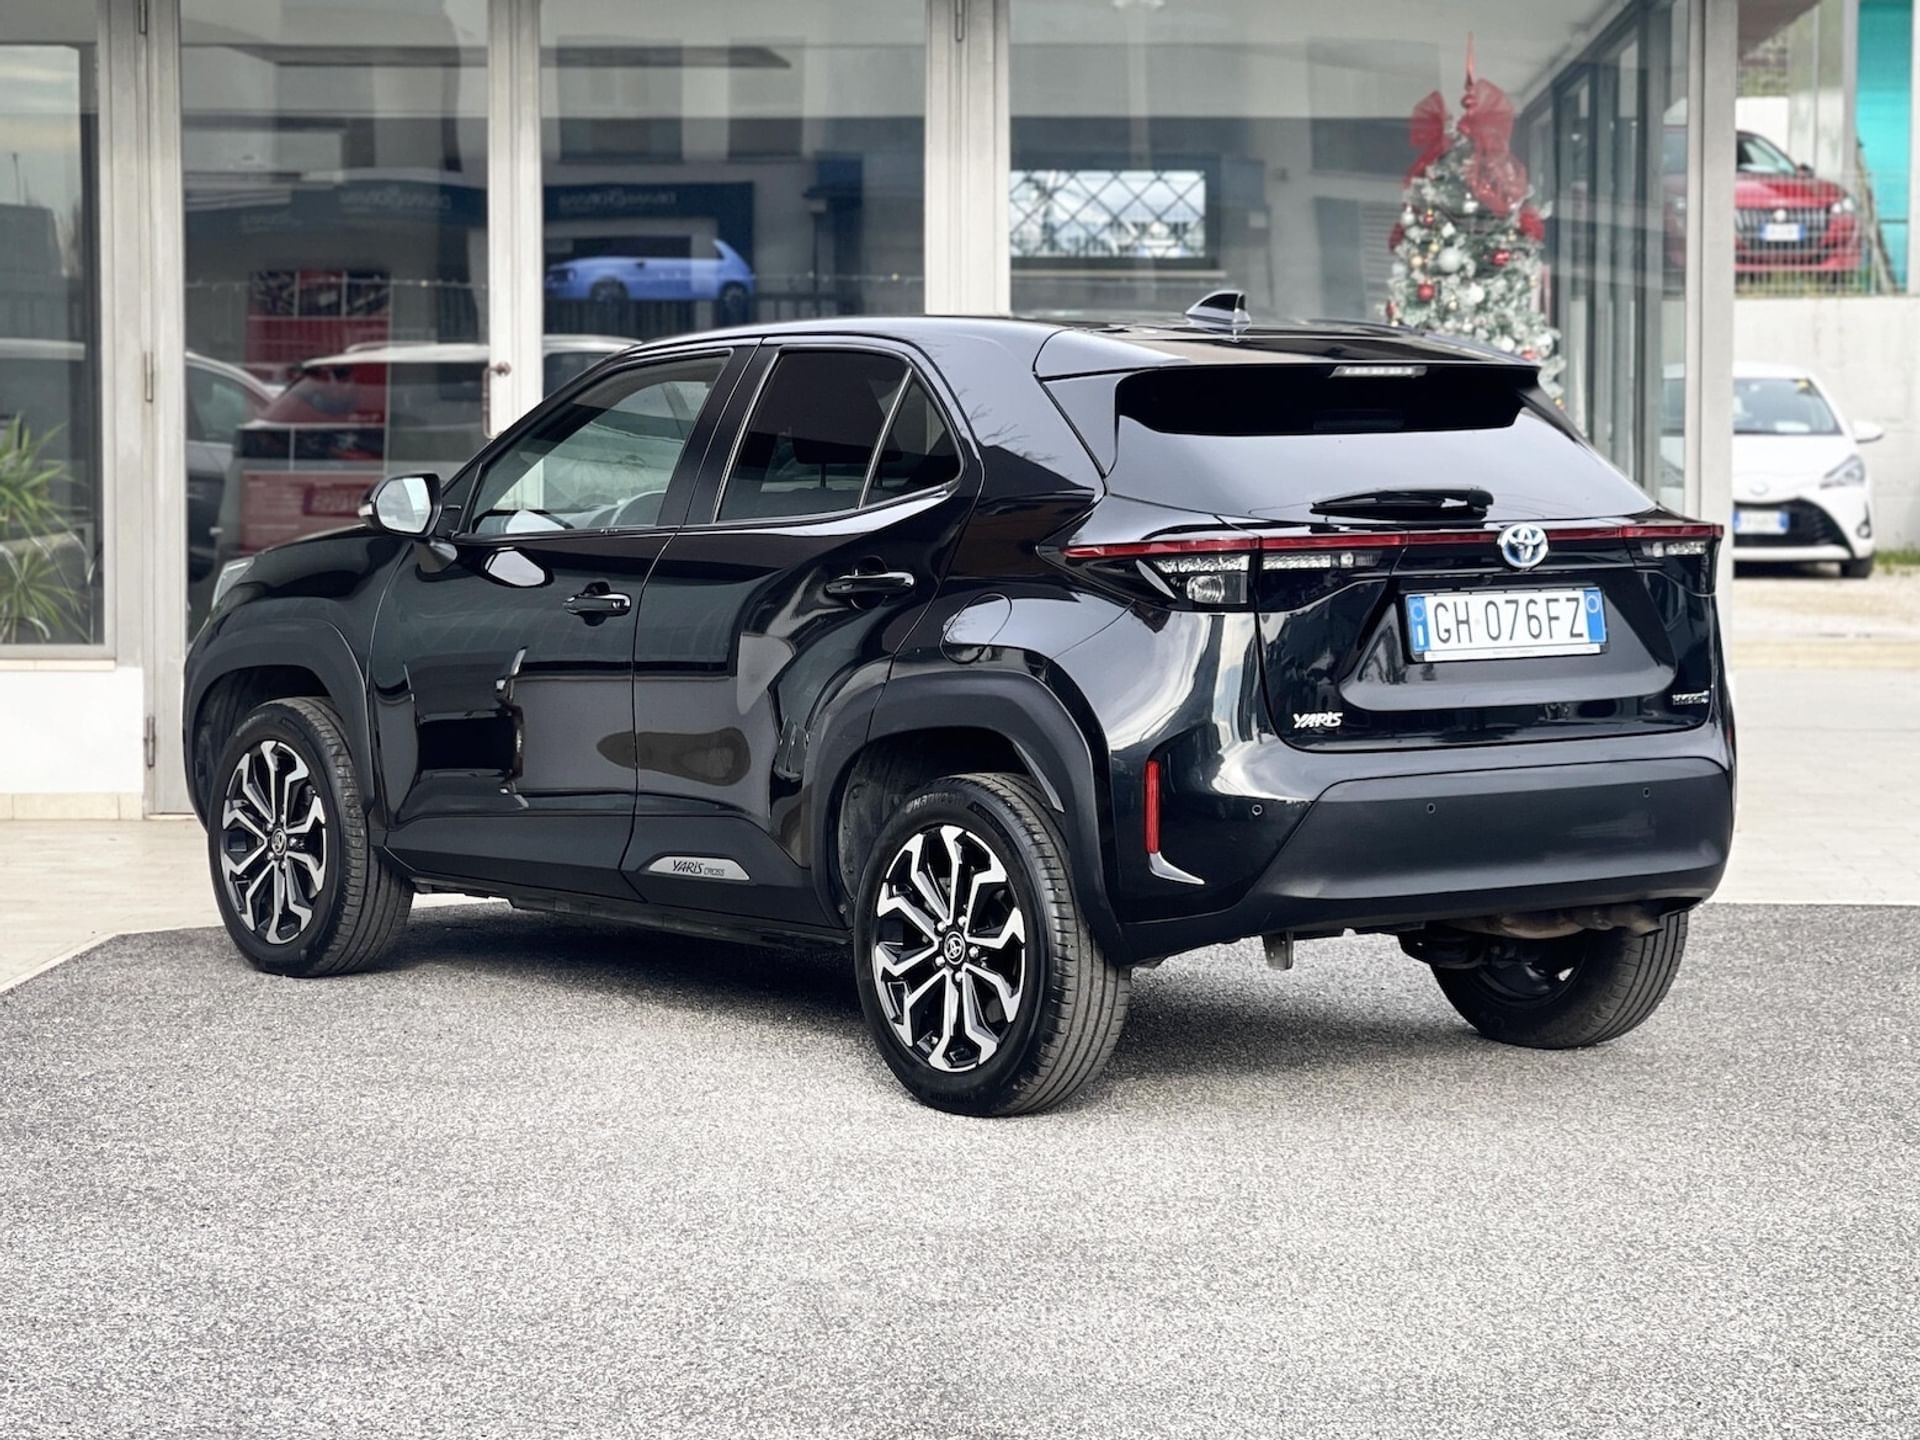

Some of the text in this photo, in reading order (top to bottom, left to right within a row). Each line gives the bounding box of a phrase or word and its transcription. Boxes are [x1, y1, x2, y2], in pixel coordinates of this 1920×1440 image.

[1434, 596, 1584, 645] GH 076FZ
[1292, 711, 1344, 729] YARIS
[672, 859, 704, 875] YARIS
